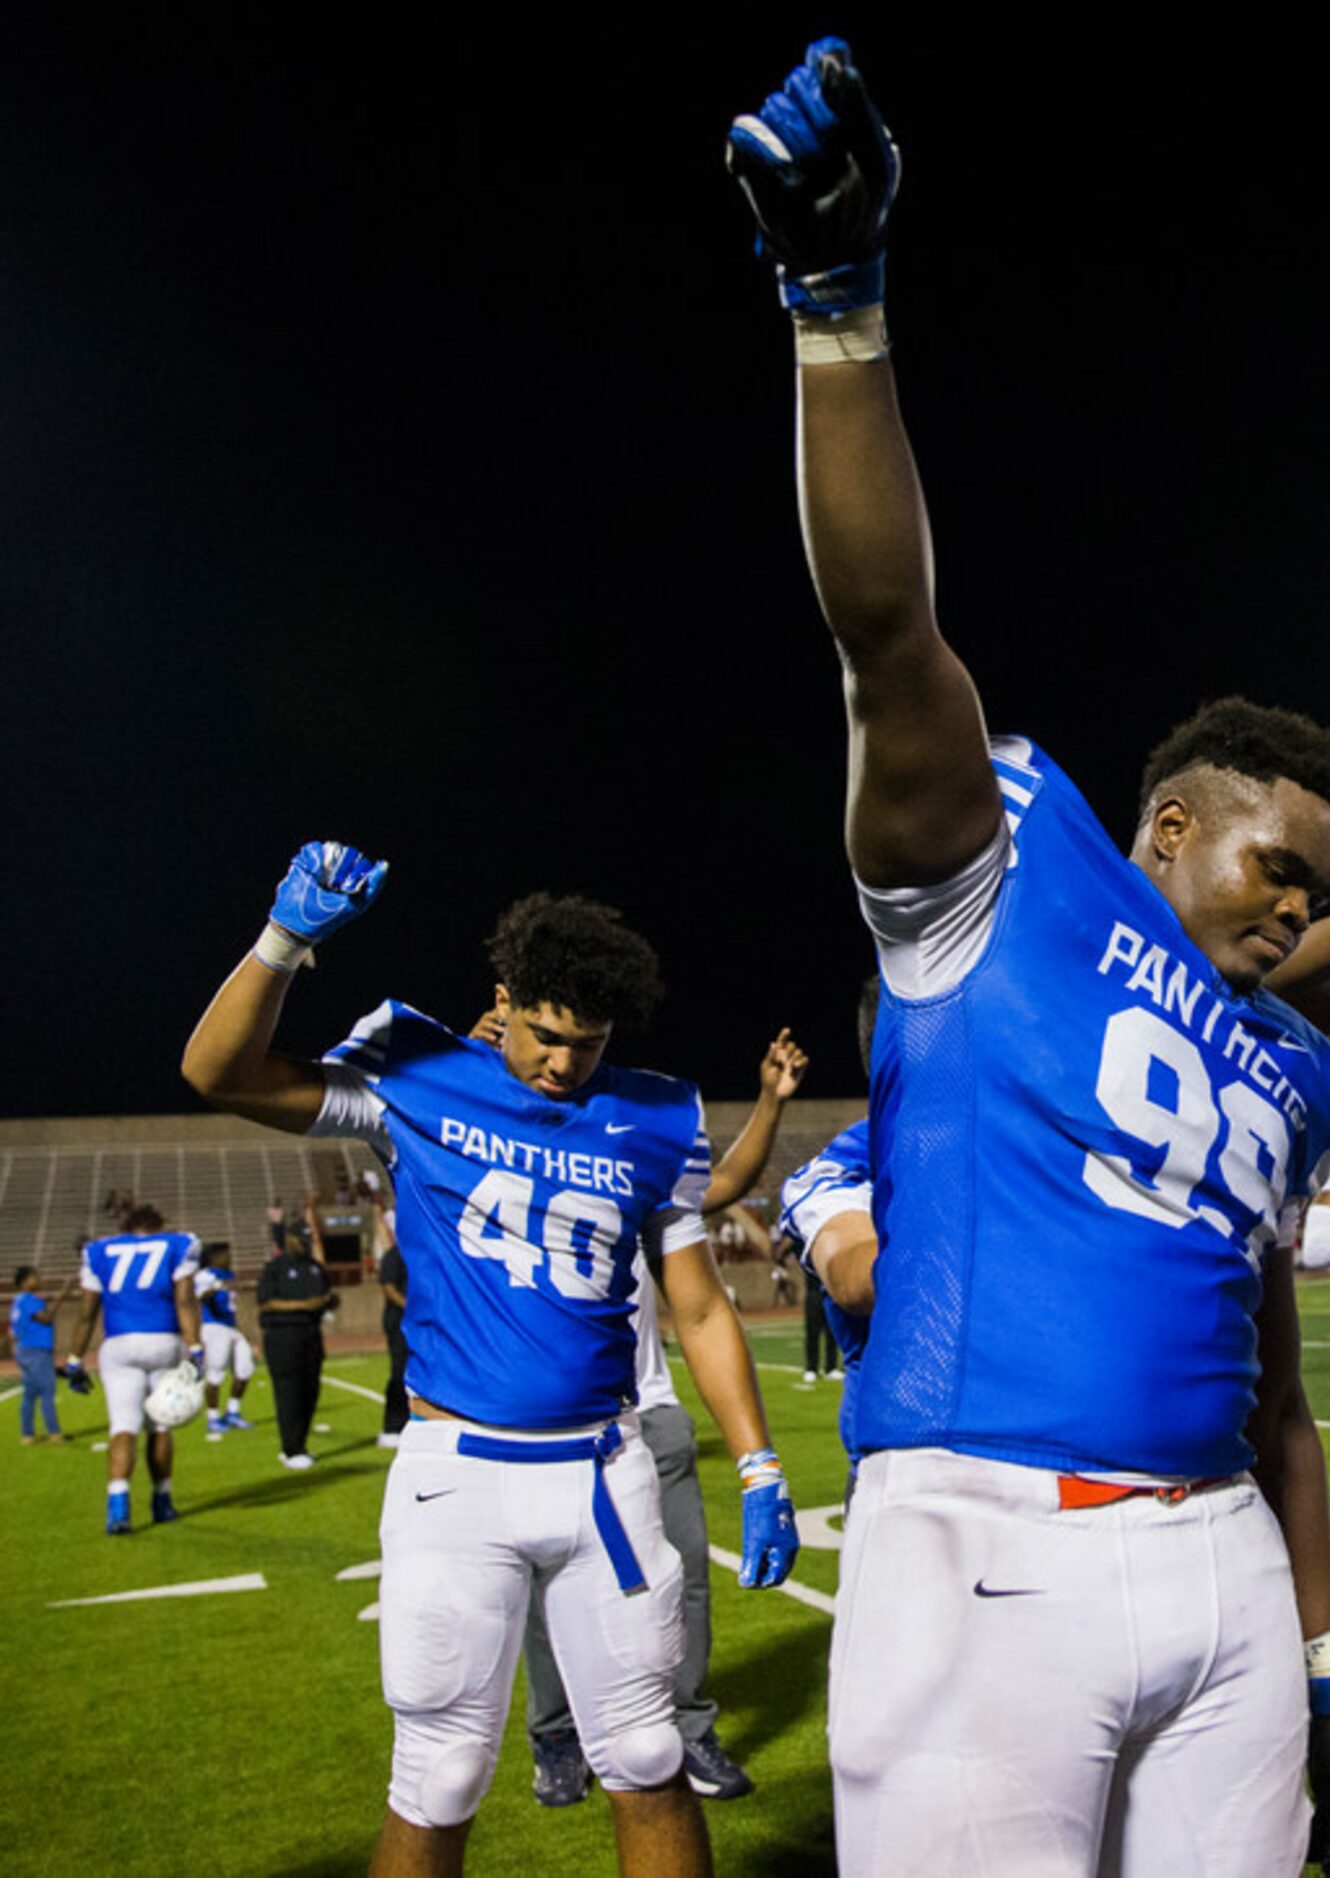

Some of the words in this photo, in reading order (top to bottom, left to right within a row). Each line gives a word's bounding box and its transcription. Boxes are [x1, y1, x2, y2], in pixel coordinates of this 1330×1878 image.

[441, 1116, 634, 1196] PANTHERS
[1083, 1006, 1290, 1265] 99
[105, 1241, 168, 1293] 77
[457, 1168, 622, 1301] 40
